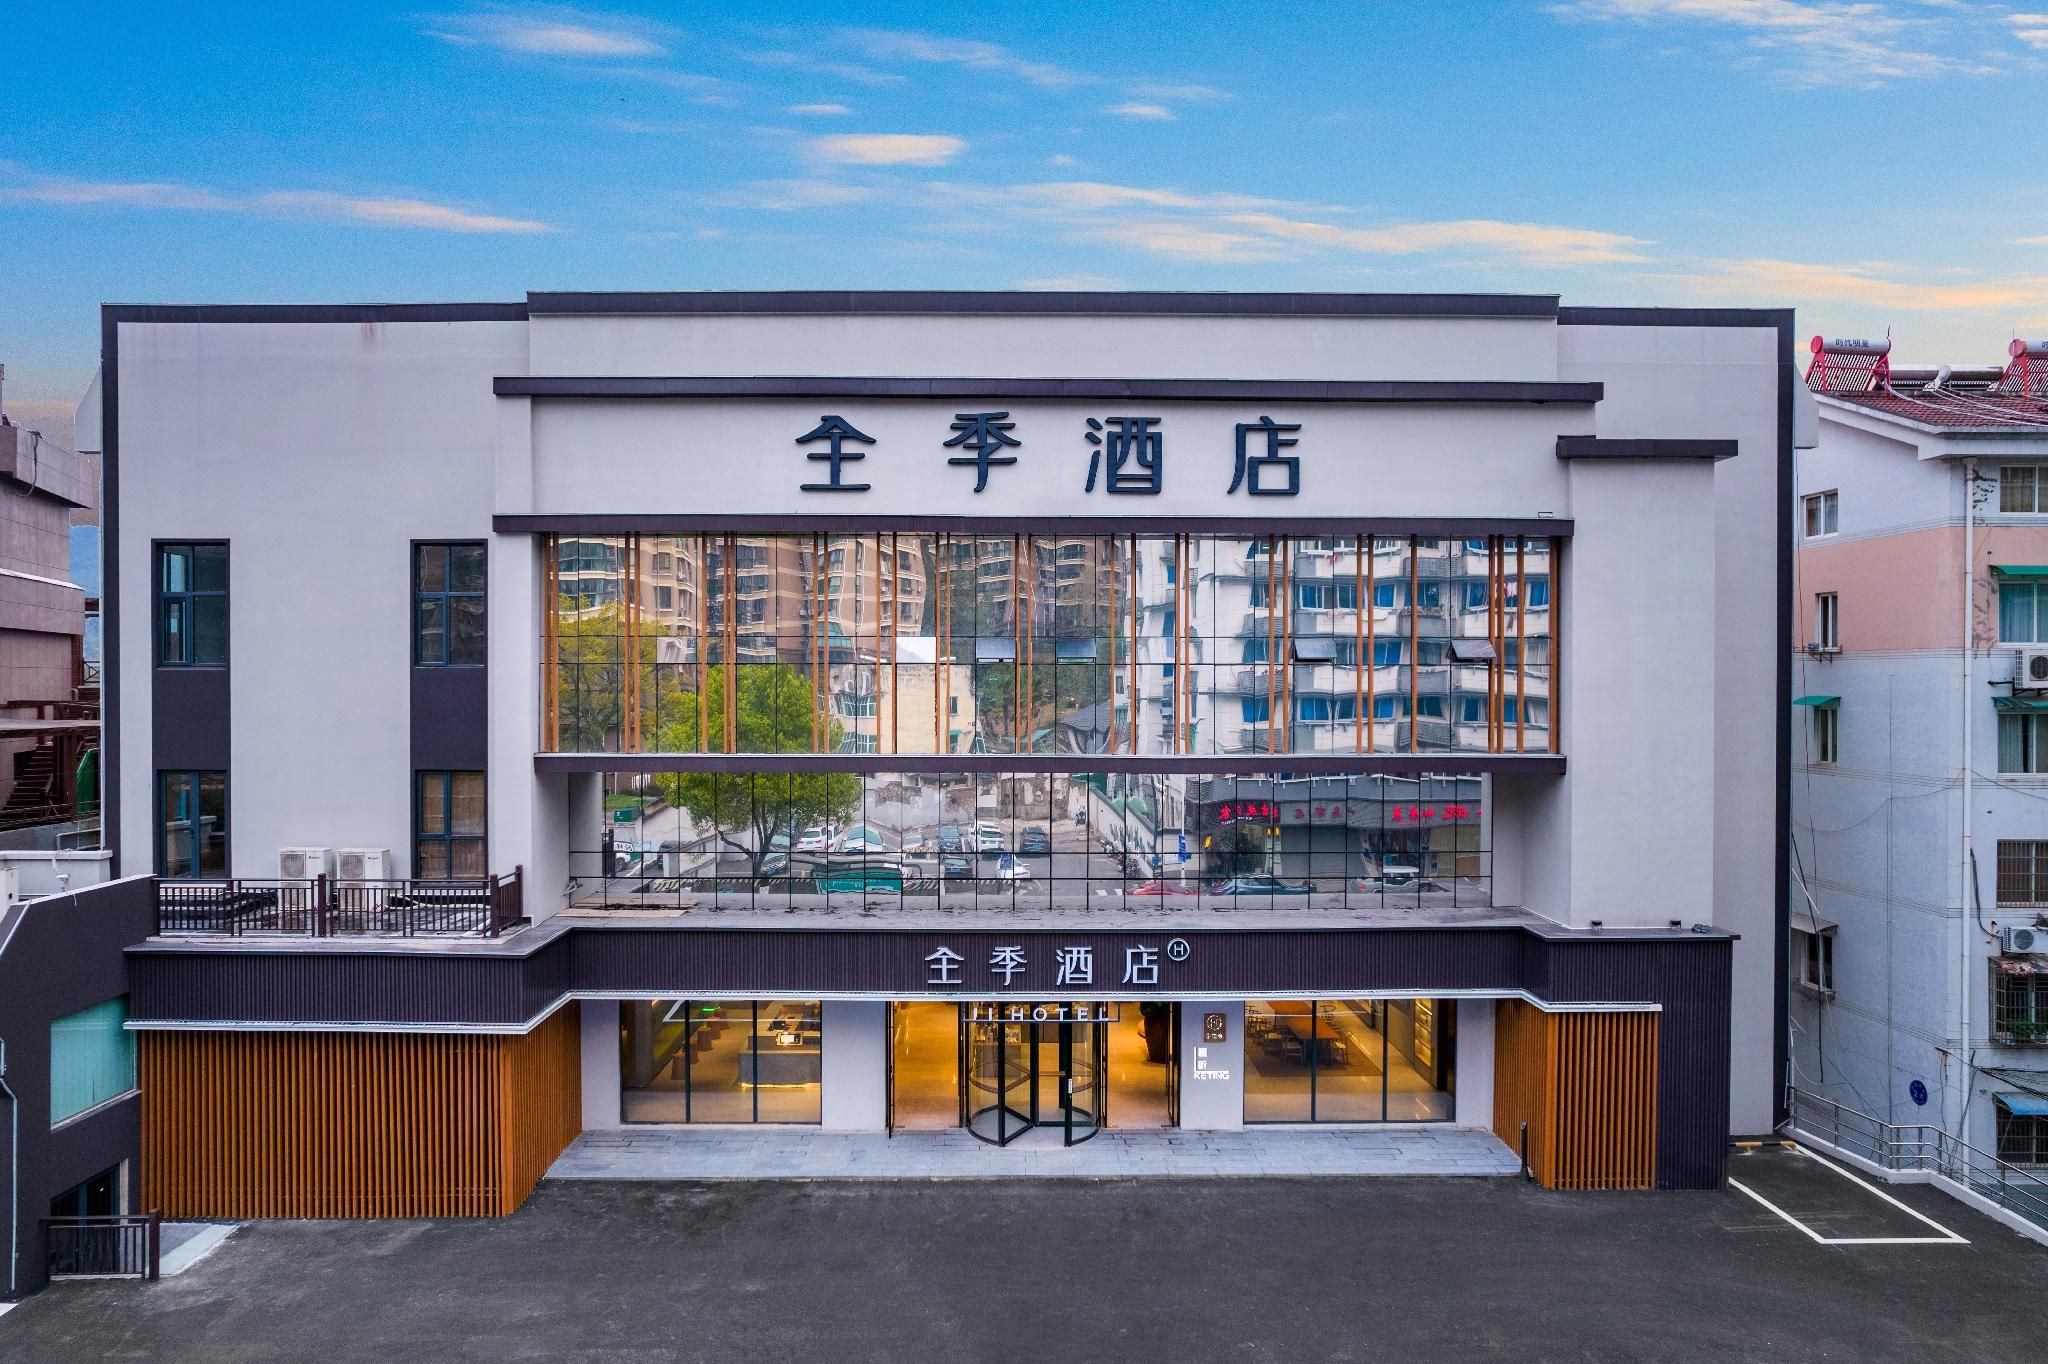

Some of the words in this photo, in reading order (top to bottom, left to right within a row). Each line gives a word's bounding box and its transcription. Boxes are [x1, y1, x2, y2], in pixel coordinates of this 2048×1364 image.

[796, 411, 1302, 495] 全季酒店
[925, 944, 1159, 986] 全季酒店
[1011, 1007, 1109, 1021] HOTEL
[1194, 1071, 1230, 1080] KETING
